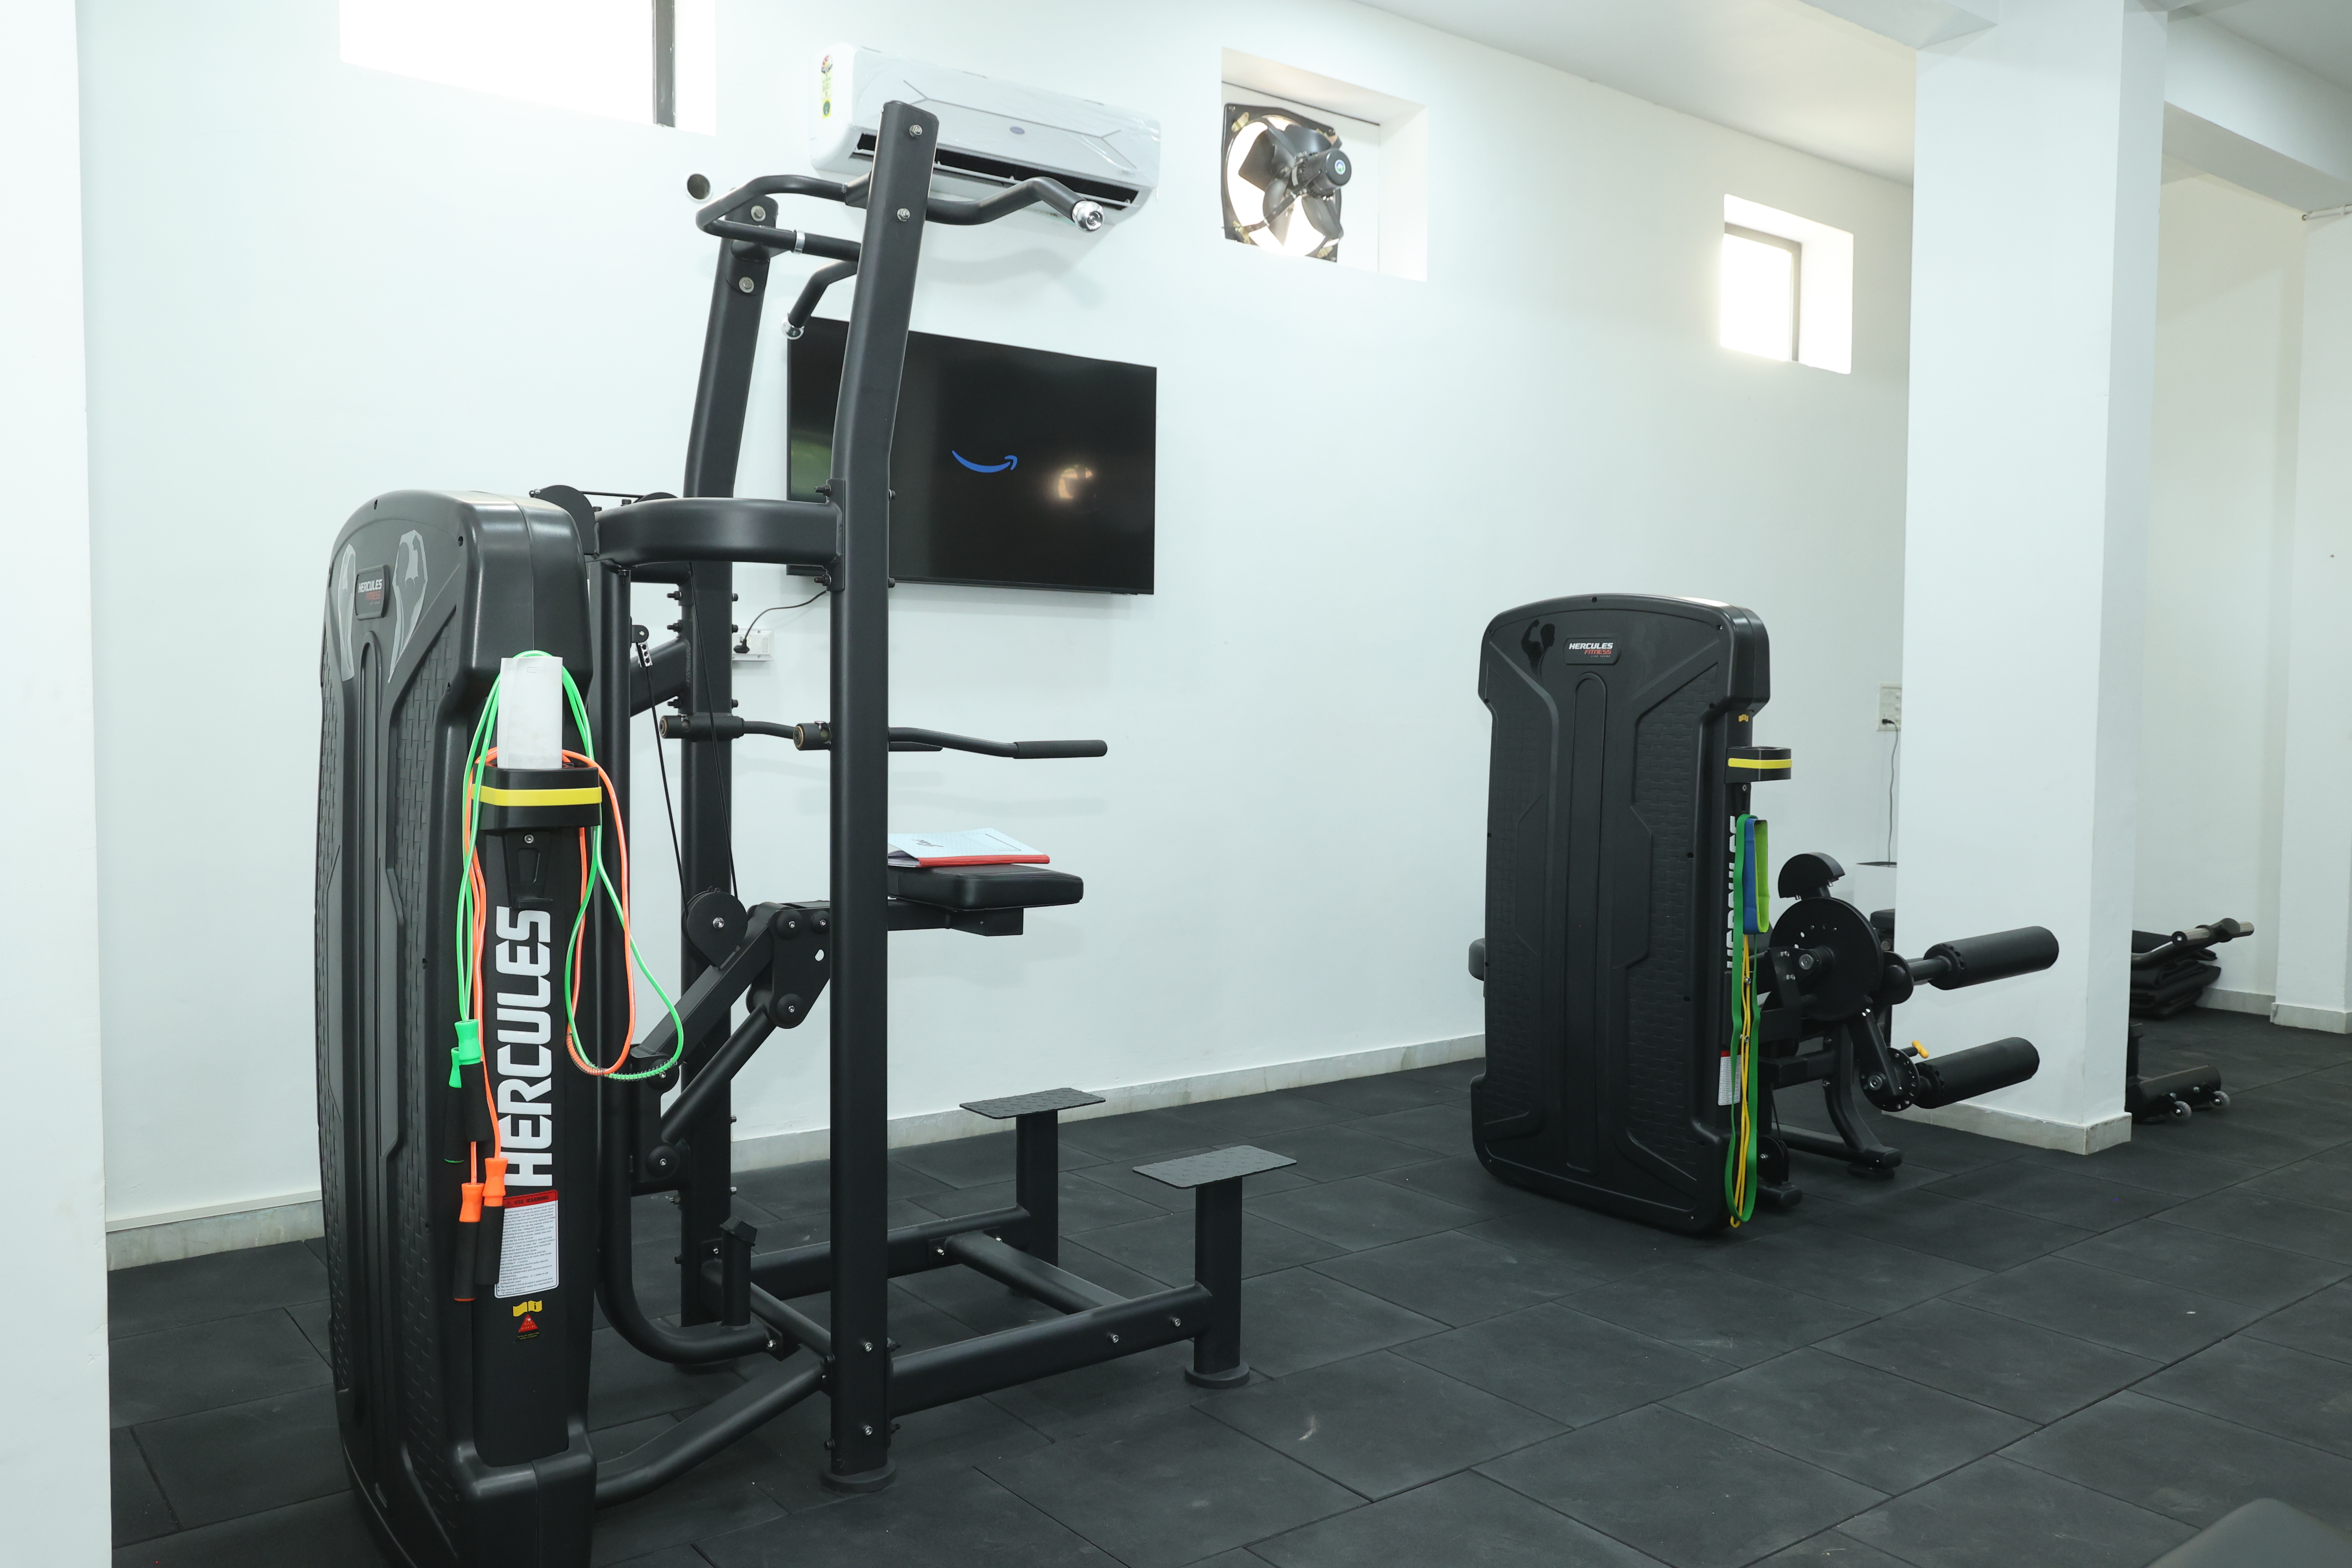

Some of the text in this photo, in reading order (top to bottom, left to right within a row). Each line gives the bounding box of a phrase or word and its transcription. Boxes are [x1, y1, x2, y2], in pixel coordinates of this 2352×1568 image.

[358, 579, 383, 593] HERCULES
[496, 906, 552, 1186] HERCULES
[526, 1195, 548, 1203] WARNING
